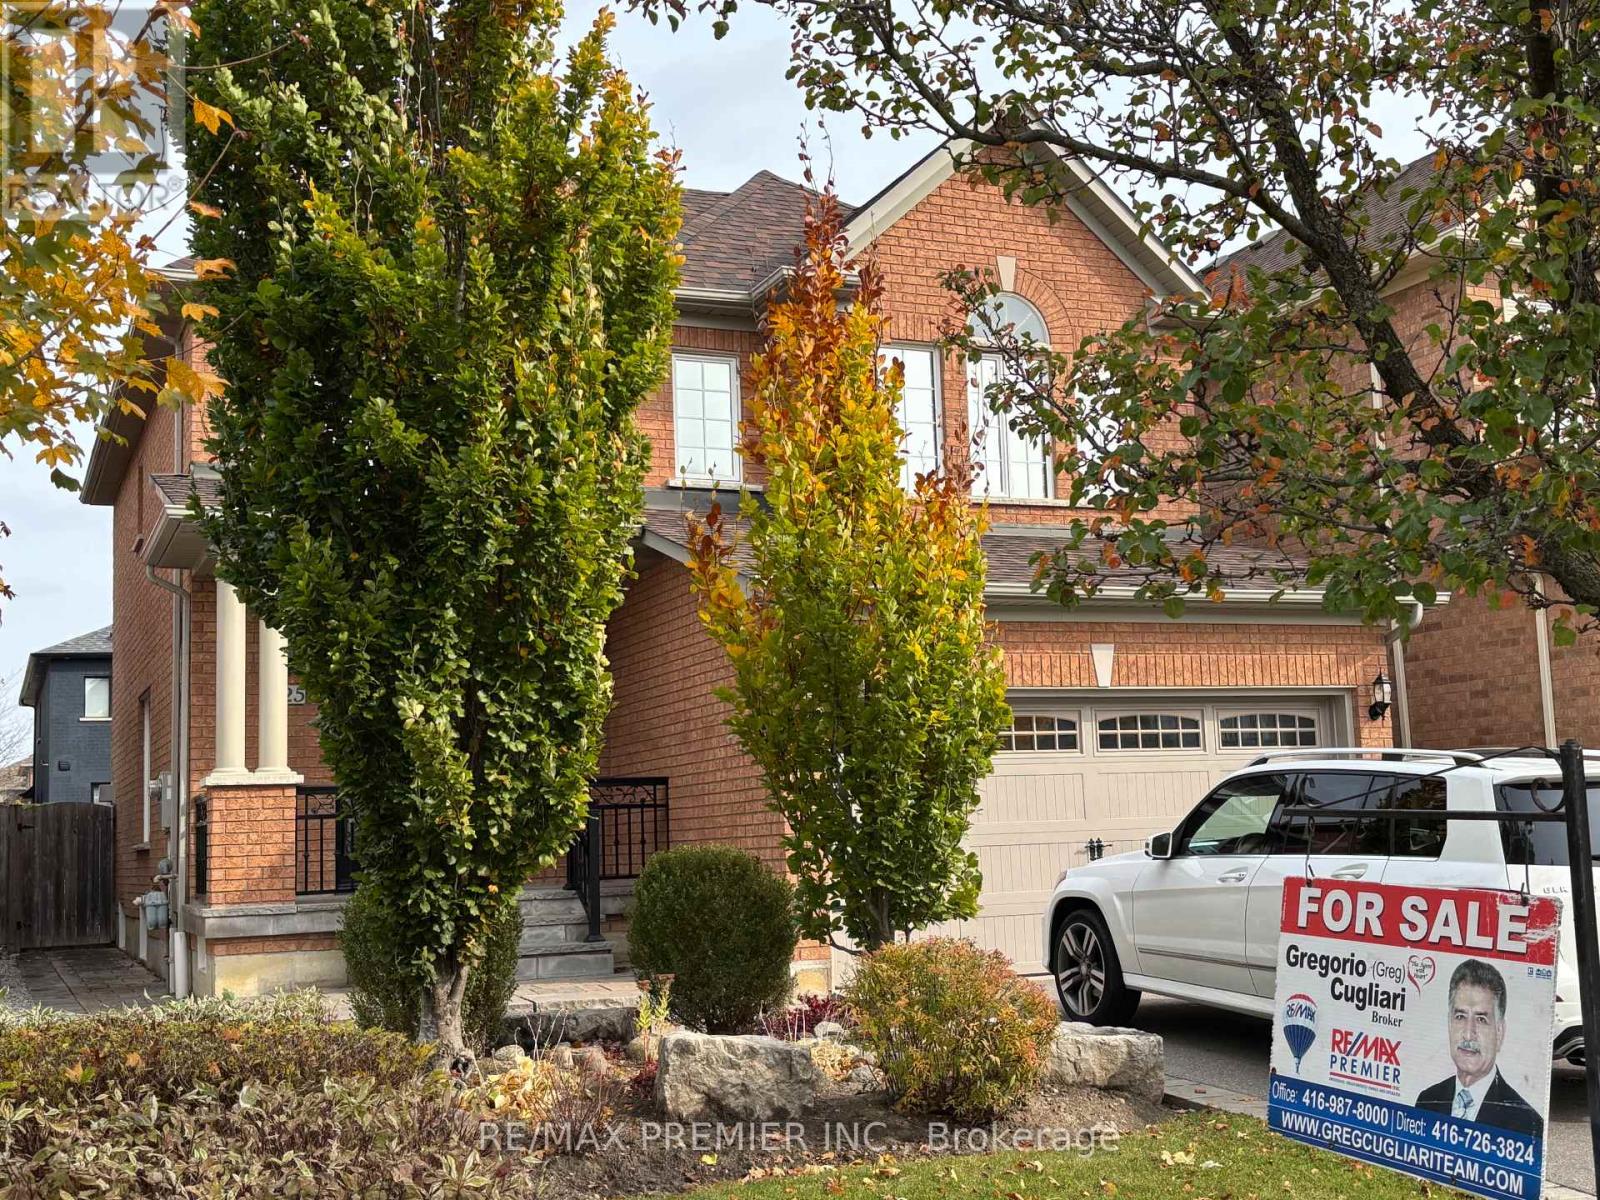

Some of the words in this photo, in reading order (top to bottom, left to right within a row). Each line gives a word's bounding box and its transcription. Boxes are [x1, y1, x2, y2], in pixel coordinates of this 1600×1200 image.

[1297, 886, 1384, 937] FOR
[1400, 895, 1530, 954] SALE
[1286, 944, 1367, 978] Gregorio
[1372, 960, 1406, 984] (Greg)
[1286, 1002, 1316, 1024] RE/MAX
[1330, 977, 1406, 1011] Cugliari
[1371, 1010, 1404, 1028] Broker
[1330, 1028, 1402, 1067] RE/MAX
[1329, 1054, 1401, 1085] PREMIER
[1272, 1081, 1298, 1104] Office:
[1302, 1089, 1389, 1127] 416-987-8000
[1396, 1111, 1427, 1137] Direct:
[1431, 1121, 1535, 1166] 416-726-3824
[1281, 1110, 1524, 1195] WWW.GREGCUGLIARITEAM.COM
